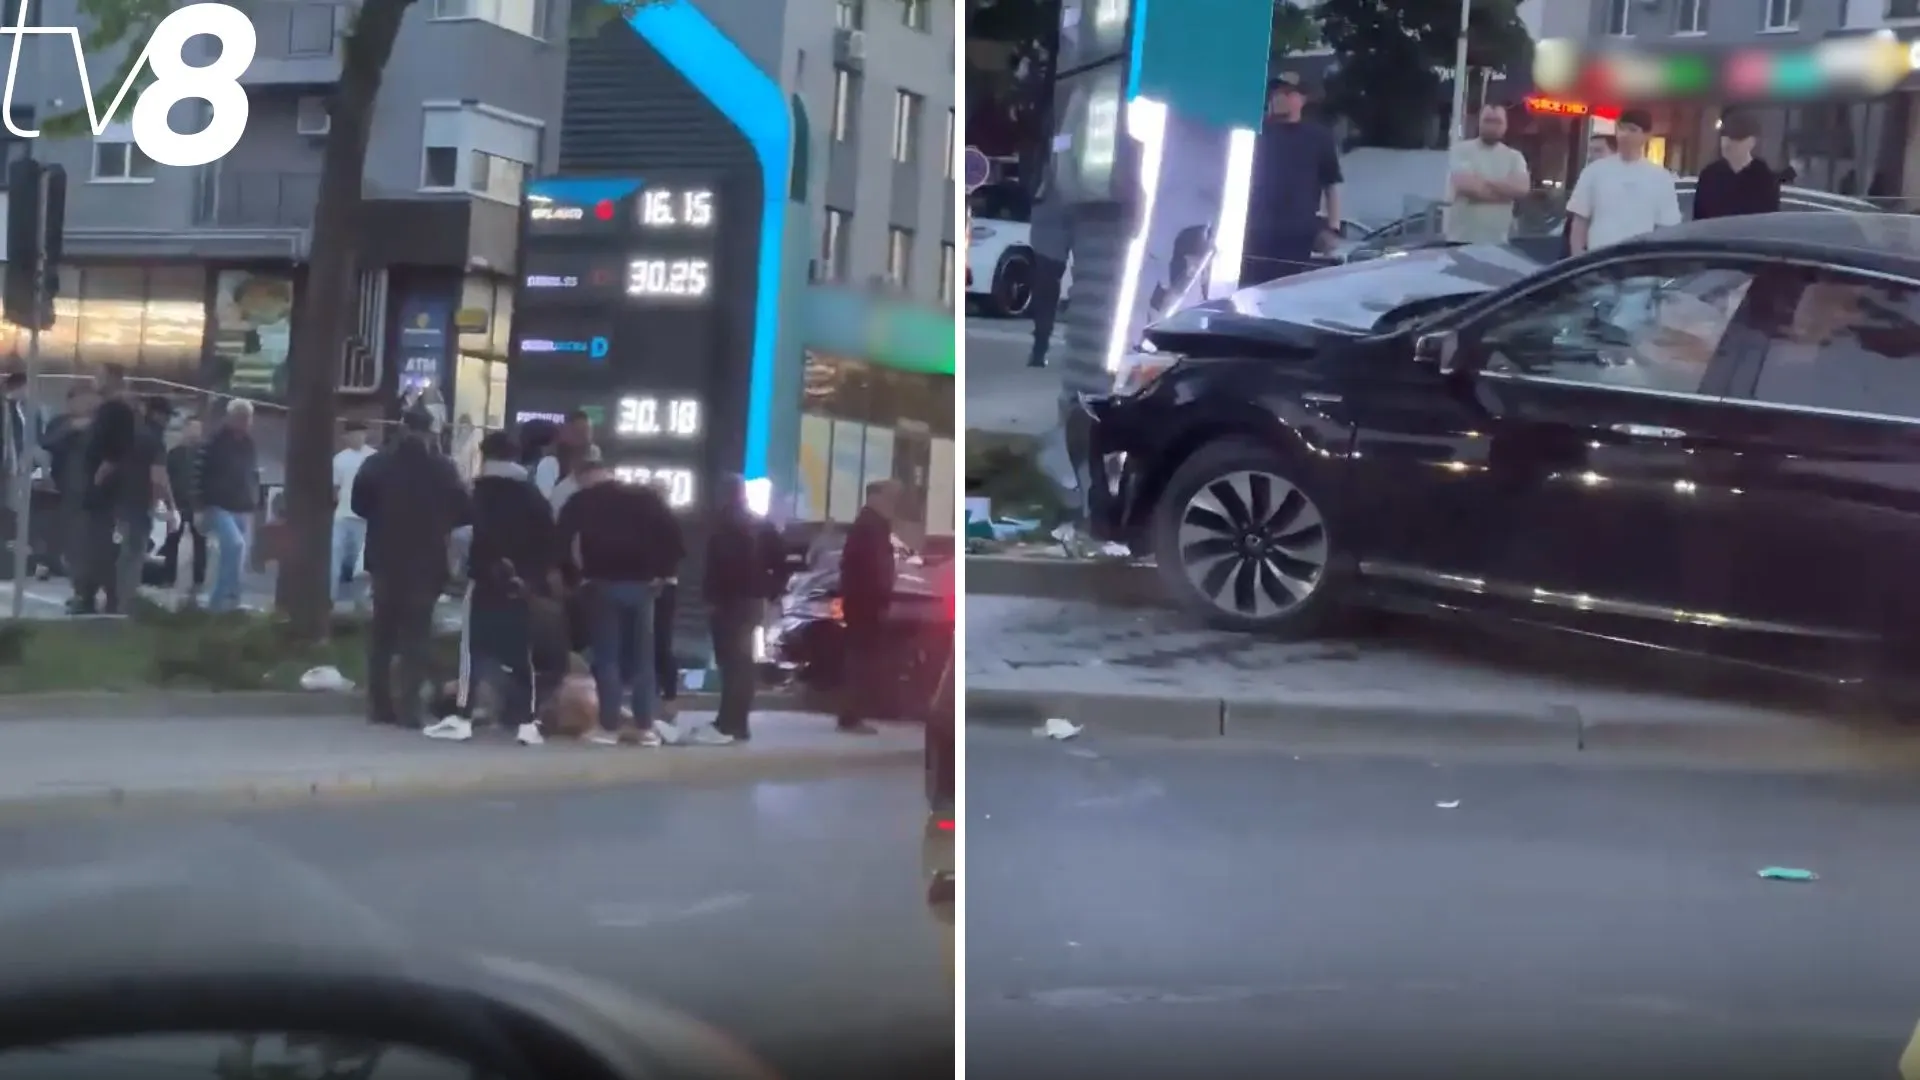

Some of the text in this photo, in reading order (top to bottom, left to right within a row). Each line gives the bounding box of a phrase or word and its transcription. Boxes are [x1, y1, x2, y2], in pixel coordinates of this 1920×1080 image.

[642, 189, 713, 227] 16.15
[626, 259, 708, 296] 30.25
[615, 397, 698, 435] 30.18
